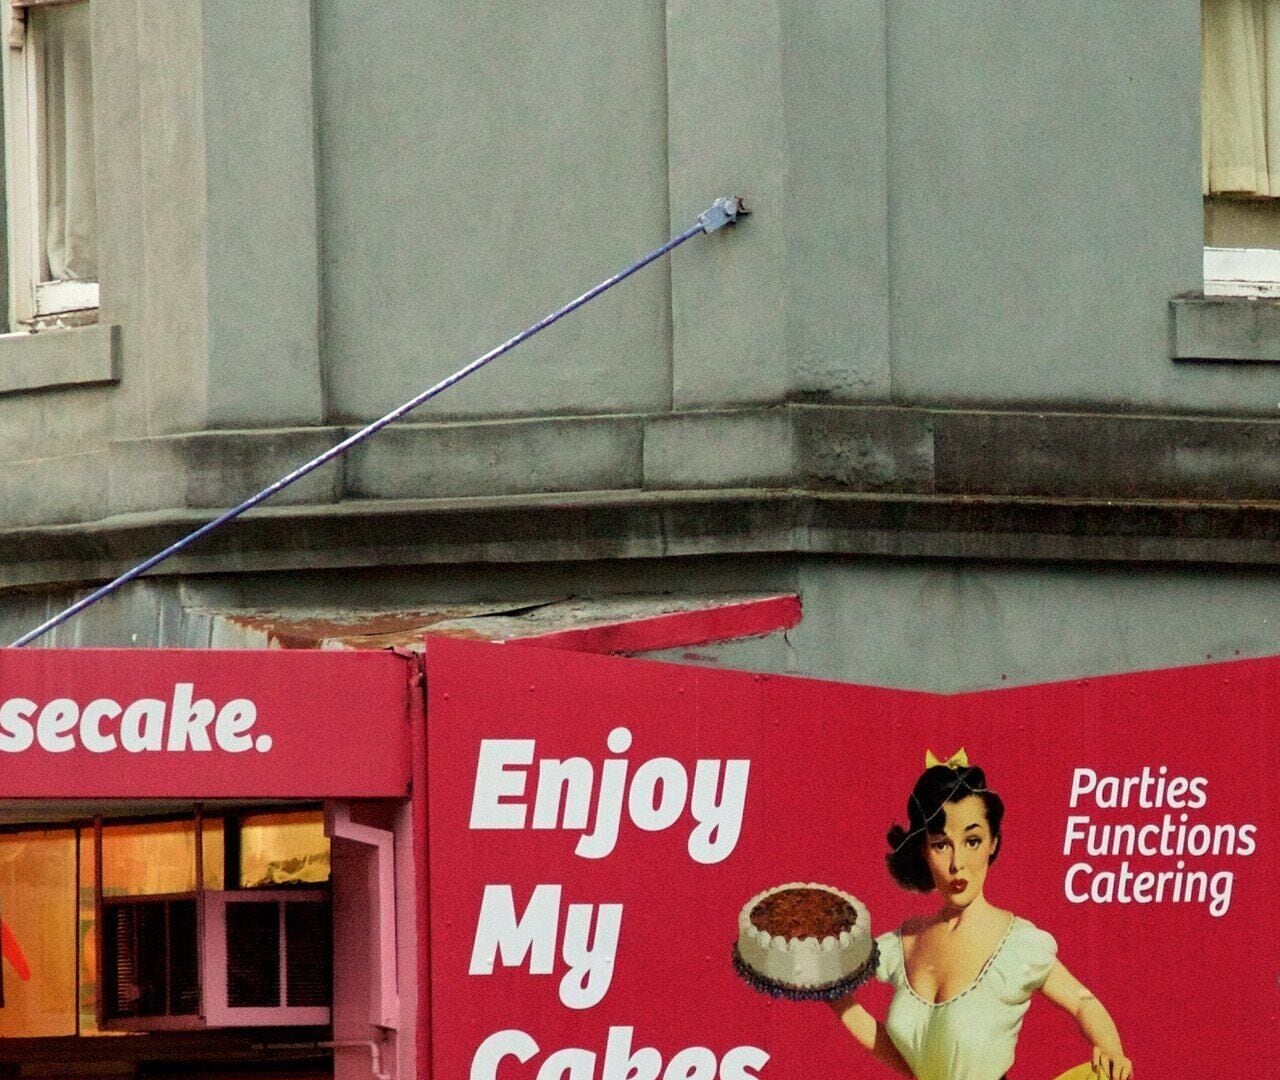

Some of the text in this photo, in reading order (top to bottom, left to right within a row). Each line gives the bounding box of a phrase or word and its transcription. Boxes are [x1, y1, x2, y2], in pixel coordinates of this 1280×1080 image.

[469, 727, 751, 865] Enjoy
[1069, 765, 1209, 809] Parties
[1063, 814, 1258, 856] Functions
[1064, 860, 1234, 918] Catering
[469, 884, 624, 1011] My
